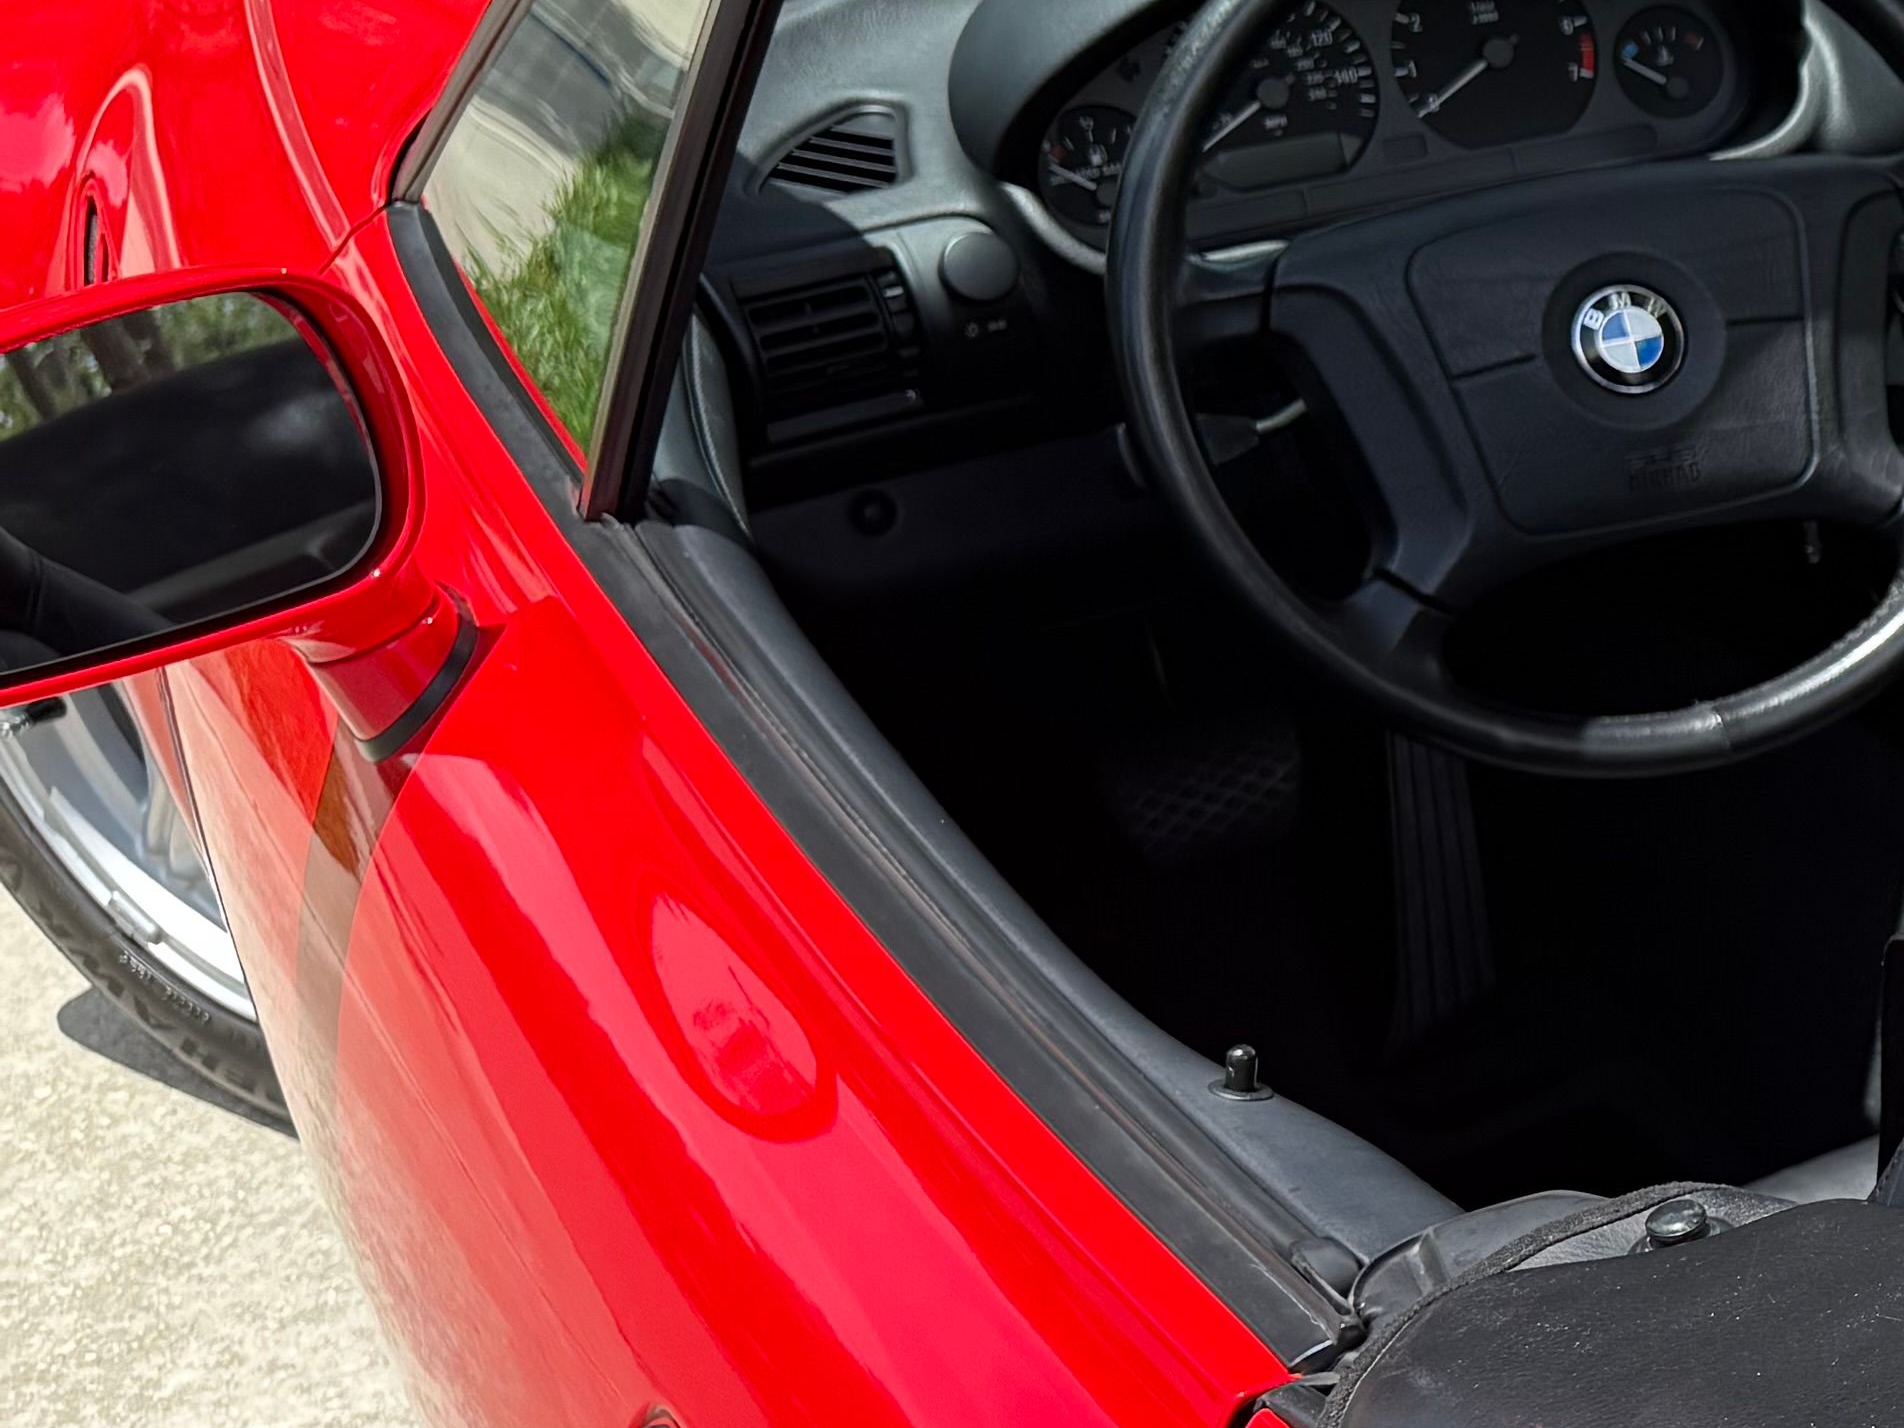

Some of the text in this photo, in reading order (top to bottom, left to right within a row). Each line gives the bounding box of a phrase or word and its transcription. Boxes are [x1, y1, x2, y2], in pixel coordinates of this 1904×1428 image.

[1408, 12, 1424, 33] 2
[1312, 28, 1333, 47] 120
[1407, 59, 1418, 79] 1
[1567, 62, 1578, 82] 7
[1583, 291, 1668, 330] BMW
